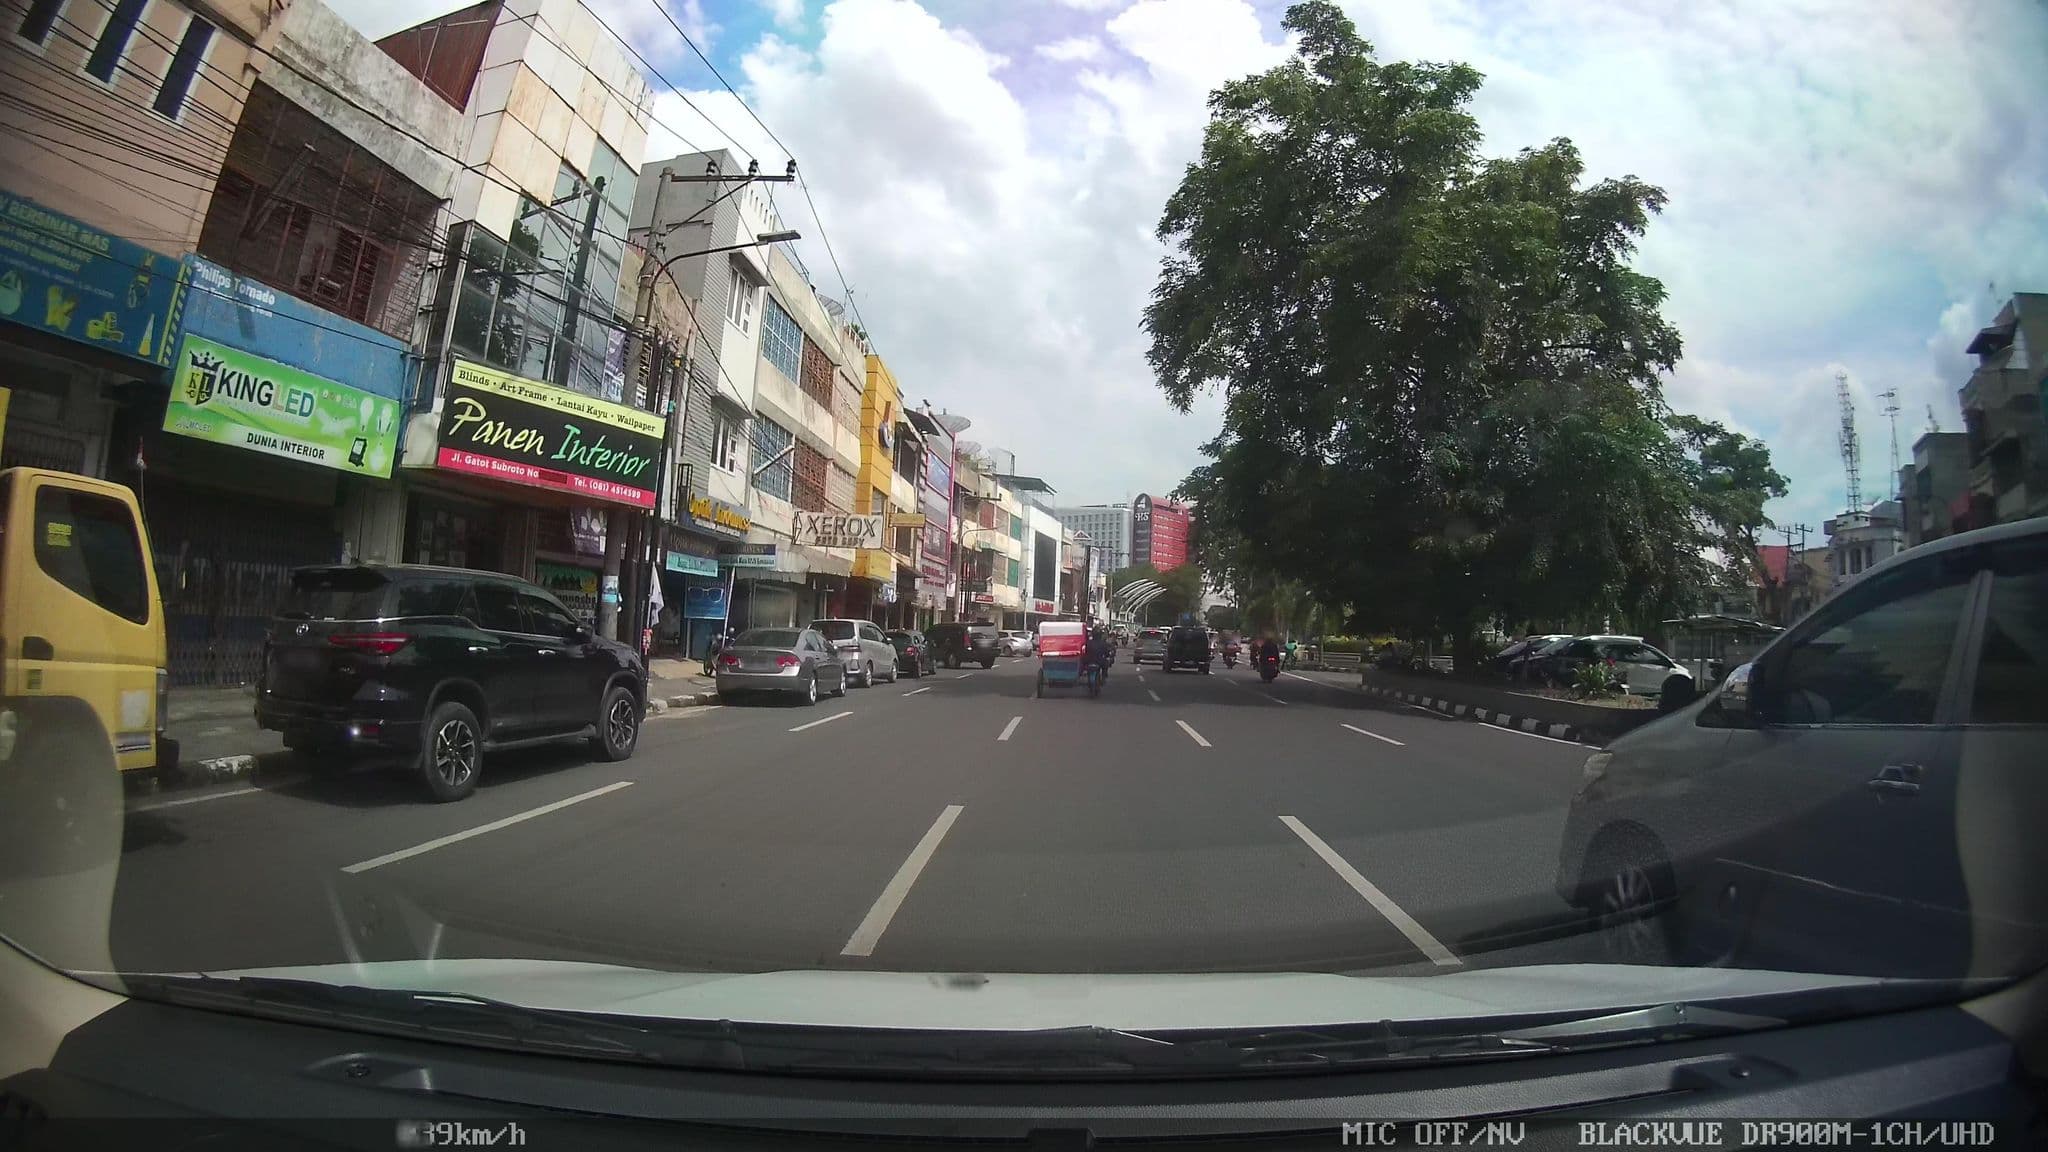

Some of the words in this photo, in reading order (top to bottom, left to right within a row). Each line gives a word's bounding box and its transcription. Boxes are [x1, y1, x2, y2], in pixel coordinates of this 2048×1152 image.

[233, 277, 276, 305] Tornado
[458, 370, 489, 386] Blinds
[499, 382, 517, 394] Art
[518, 386, 547, 402] Frame
[556, 397, 585, 412] Lantai
[587, 405, 608, 418] Kayu
[617, 414, 656, 432] Wallpaper
[448, 397, 544, 455] Panen
[247, 432, 279, 450] DUNIA
[280, 439, 325, 460] INTERIOR
[550, 424, 651, 477] Interior
[464, 456, 489, 469] Gatot
[491, 461, 525, 475] Subroto
[806, 515, 877, 538] XEROX
